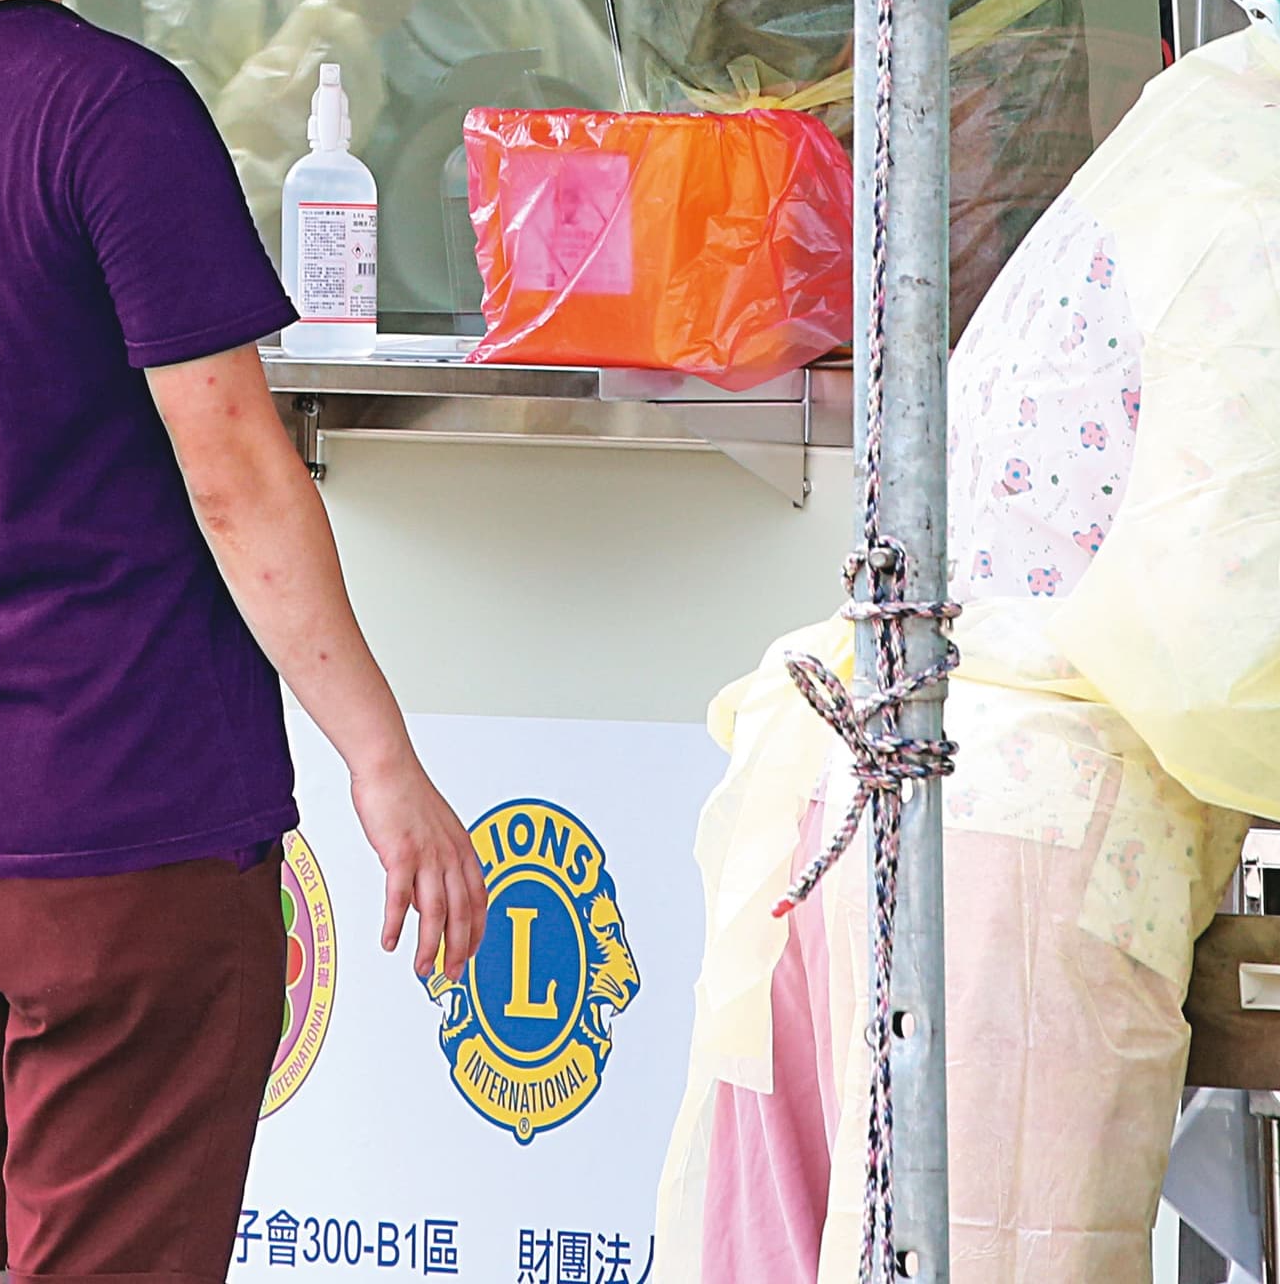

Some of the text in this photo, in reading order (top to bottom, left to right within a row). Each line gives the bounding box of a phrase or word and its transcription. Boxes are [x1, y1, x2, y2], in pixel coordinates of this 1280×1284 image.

[295, 851, 319, 893] 2021
[504, 907, 558, 1020] L
[268, 1000, 327, 1103] INTERNATIONAL
[463, 1050, 588, 1113] INTERNATIONAL
